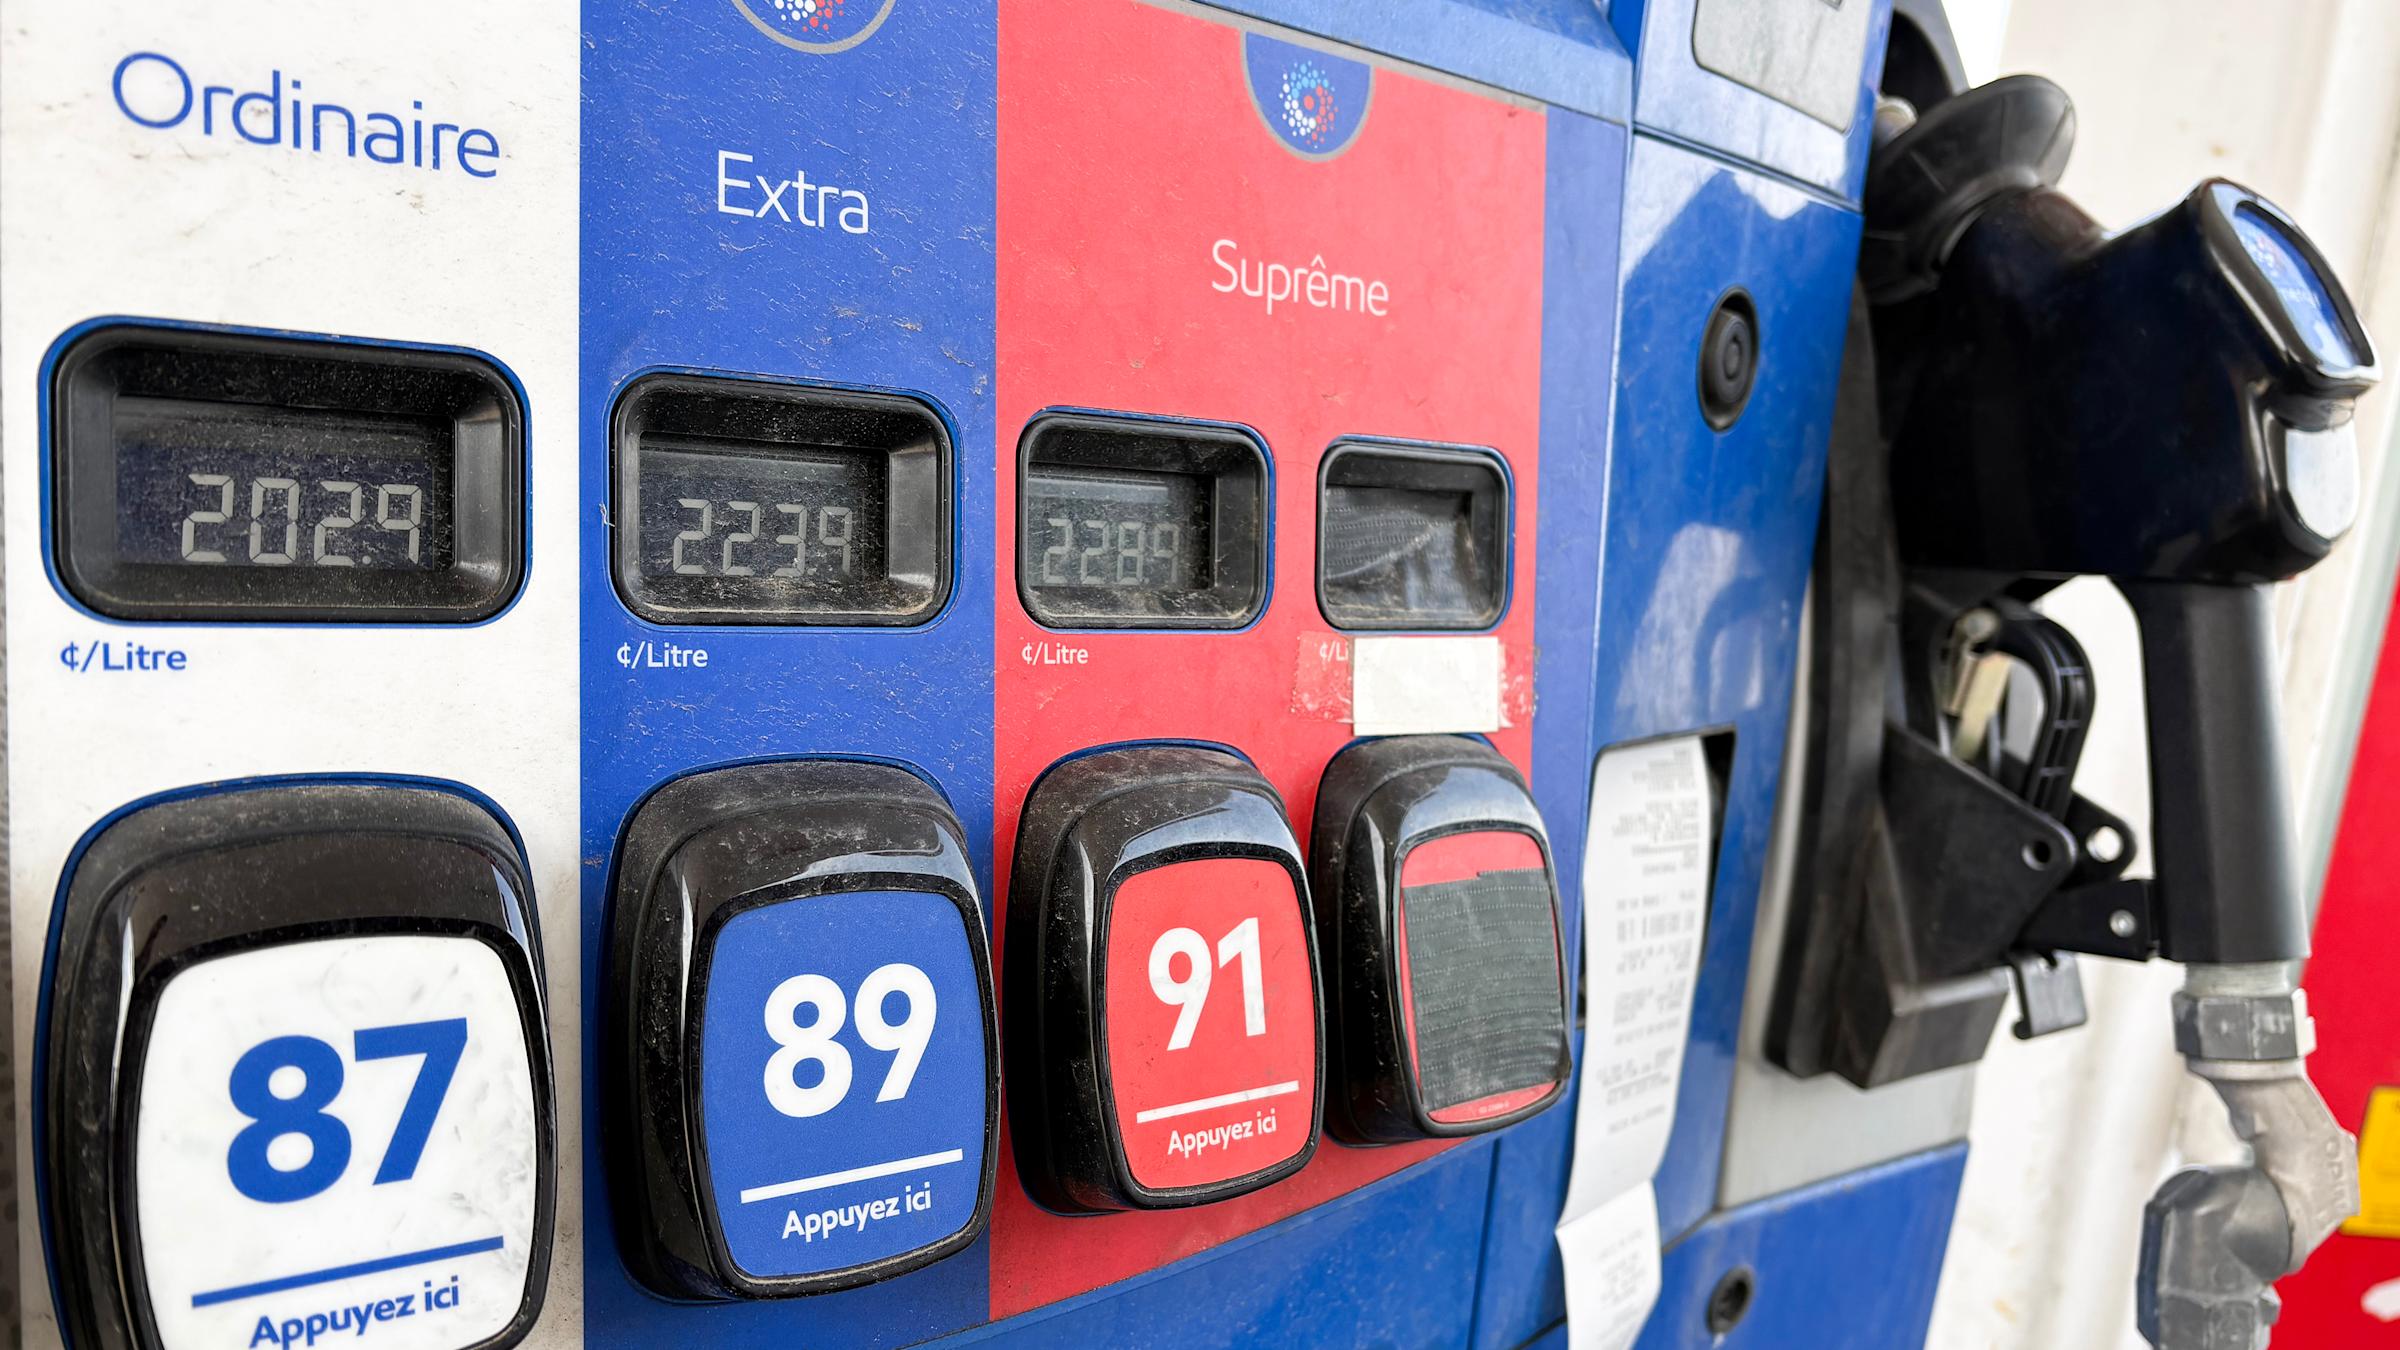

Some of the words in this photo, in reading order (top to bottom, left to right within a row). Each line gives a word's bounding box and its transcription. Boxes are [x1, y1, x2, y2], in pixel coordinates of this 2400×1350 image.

[112, 52, 500, 178] Ordinaire
[718, 150, 870, 234] Extra
[1212, 239, 1390, 317] Suprême
[182, 473, 422, 566] 202.9
[59, 641, 187, 673] ¢/Litre
[617, 641, 709, 670] ¢/Litre
[1021, 641, 1089, 666] ¢/Litre
[1147, 917, 1267, 1051] 91
[763, 963, 938, 1118] 89
[227, 1017, 468, 1204] 87
[1167, 1121, 1254, 1159] Appuyez
[1256, 1107, 1277, 1135] ici
[781, 1195, 900, 1243] Appuyez
[904, 1181, 932, 1214] ici
[248, 1293, 416, 1350] Appuyez
[423, 1274, 460, 1312] ici
